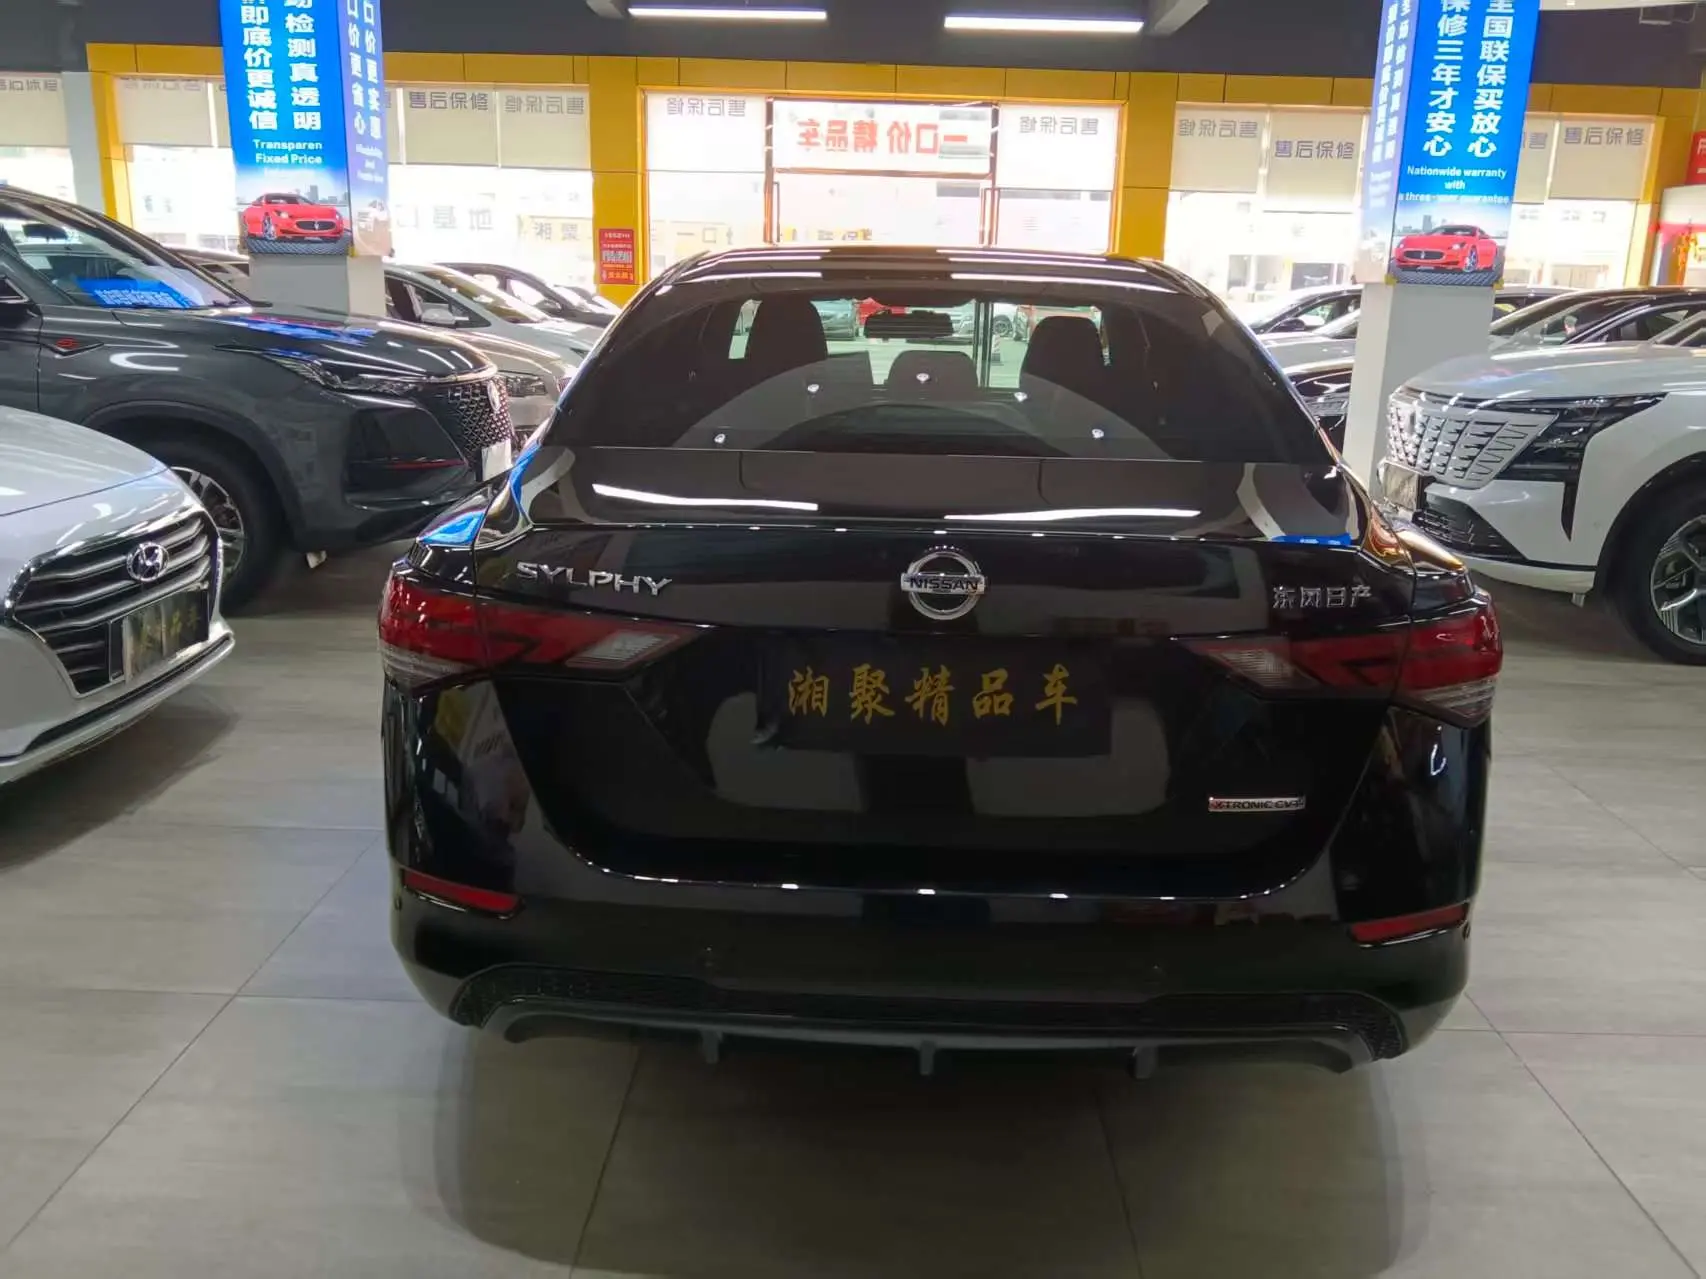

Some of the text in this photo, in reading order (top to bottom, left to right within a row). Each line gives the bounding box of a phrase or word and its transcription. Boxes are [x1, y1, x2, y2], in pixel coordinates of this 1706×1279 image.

[241, 0, 278, 130] 即底价更诚信
[409, 91, 489, 111] 售后保修
[1564, 127, 1644, 146] 售后保修
[290, 153, 322, 164] Price
[1274, 140, 1355, 160] 售后保修
[1407, 165, 1507, 180] Nationwide warranty
[1444, 180, 1466, 190] with
[517, 561, 673, 596] SYLPHY
[909, 577, 980, 590] NISSAN
[1273, 585, 1372, 610] 东风日产
[788, 663, 1078, 726] 湘聚精品车
